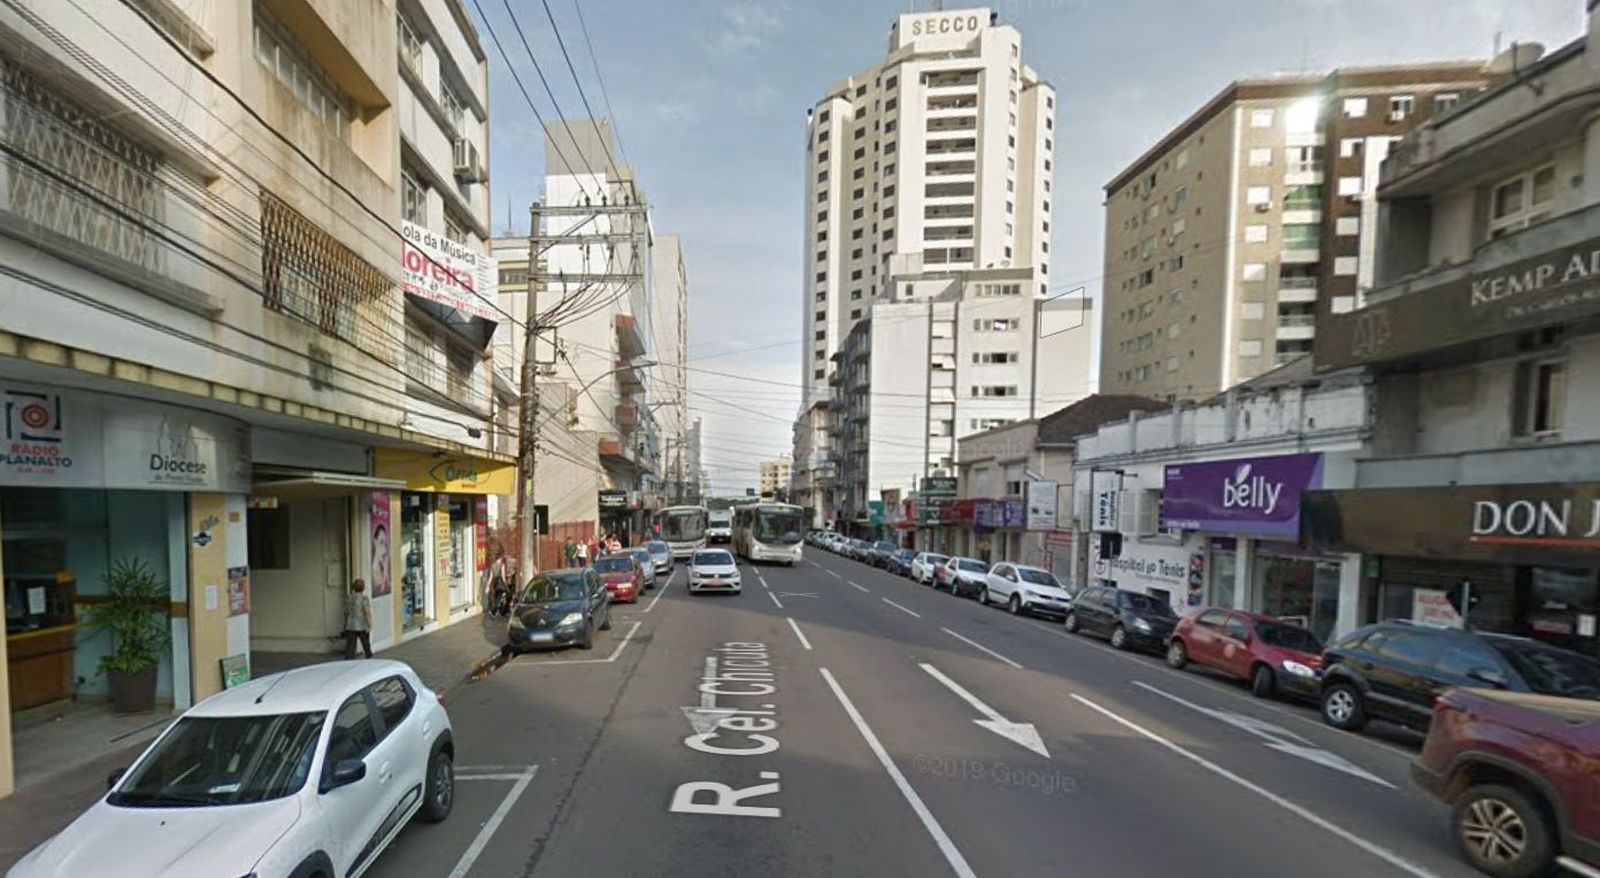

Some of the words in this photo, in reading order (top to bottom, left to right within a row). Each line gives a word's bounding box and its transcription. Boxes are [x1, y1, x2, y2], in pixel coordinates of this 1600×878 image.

[912, 15, 978, 36] SECCO
[424, 234, 438, 250] da
[1470, 264, 1556, 306] KEMP
[150, 453, 207, 475] Diocese
[1223, 475, 1283, 515] belly
[1472, 499, 1572, 536] DON
